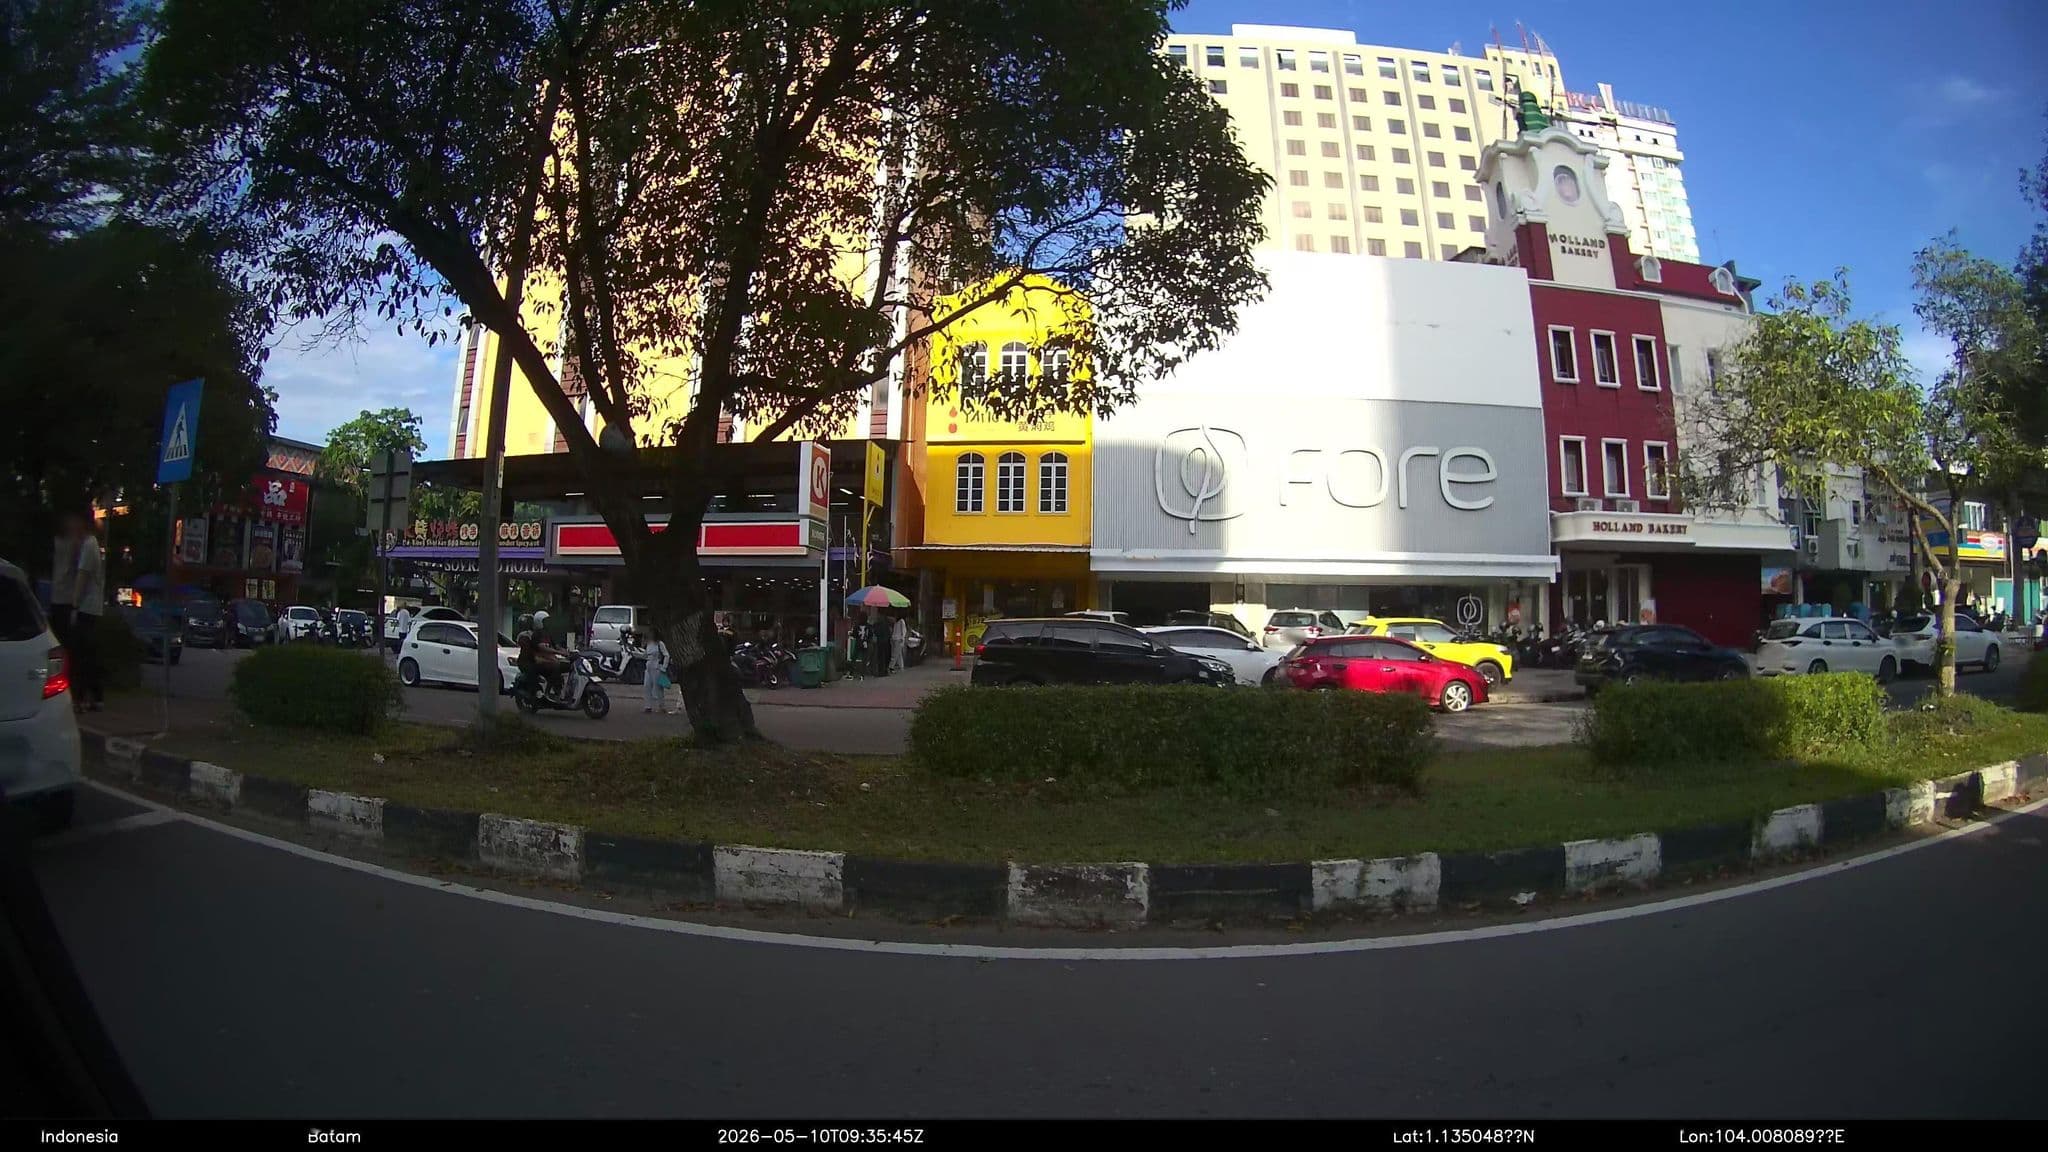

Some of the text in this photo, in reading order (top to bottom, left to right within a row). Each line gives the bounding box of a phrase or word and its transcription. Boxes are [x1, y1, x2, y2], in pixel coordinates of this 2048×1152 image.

[1549, 233, 1606, 249] HOLLAND
[1561, 245, 1599, 259] BAKERY
[816, 465, 826, 496] K
[1592, 520, 1688, 535] HOLLAND BAKERY
[504, 558, 548, 573] HOTEL
